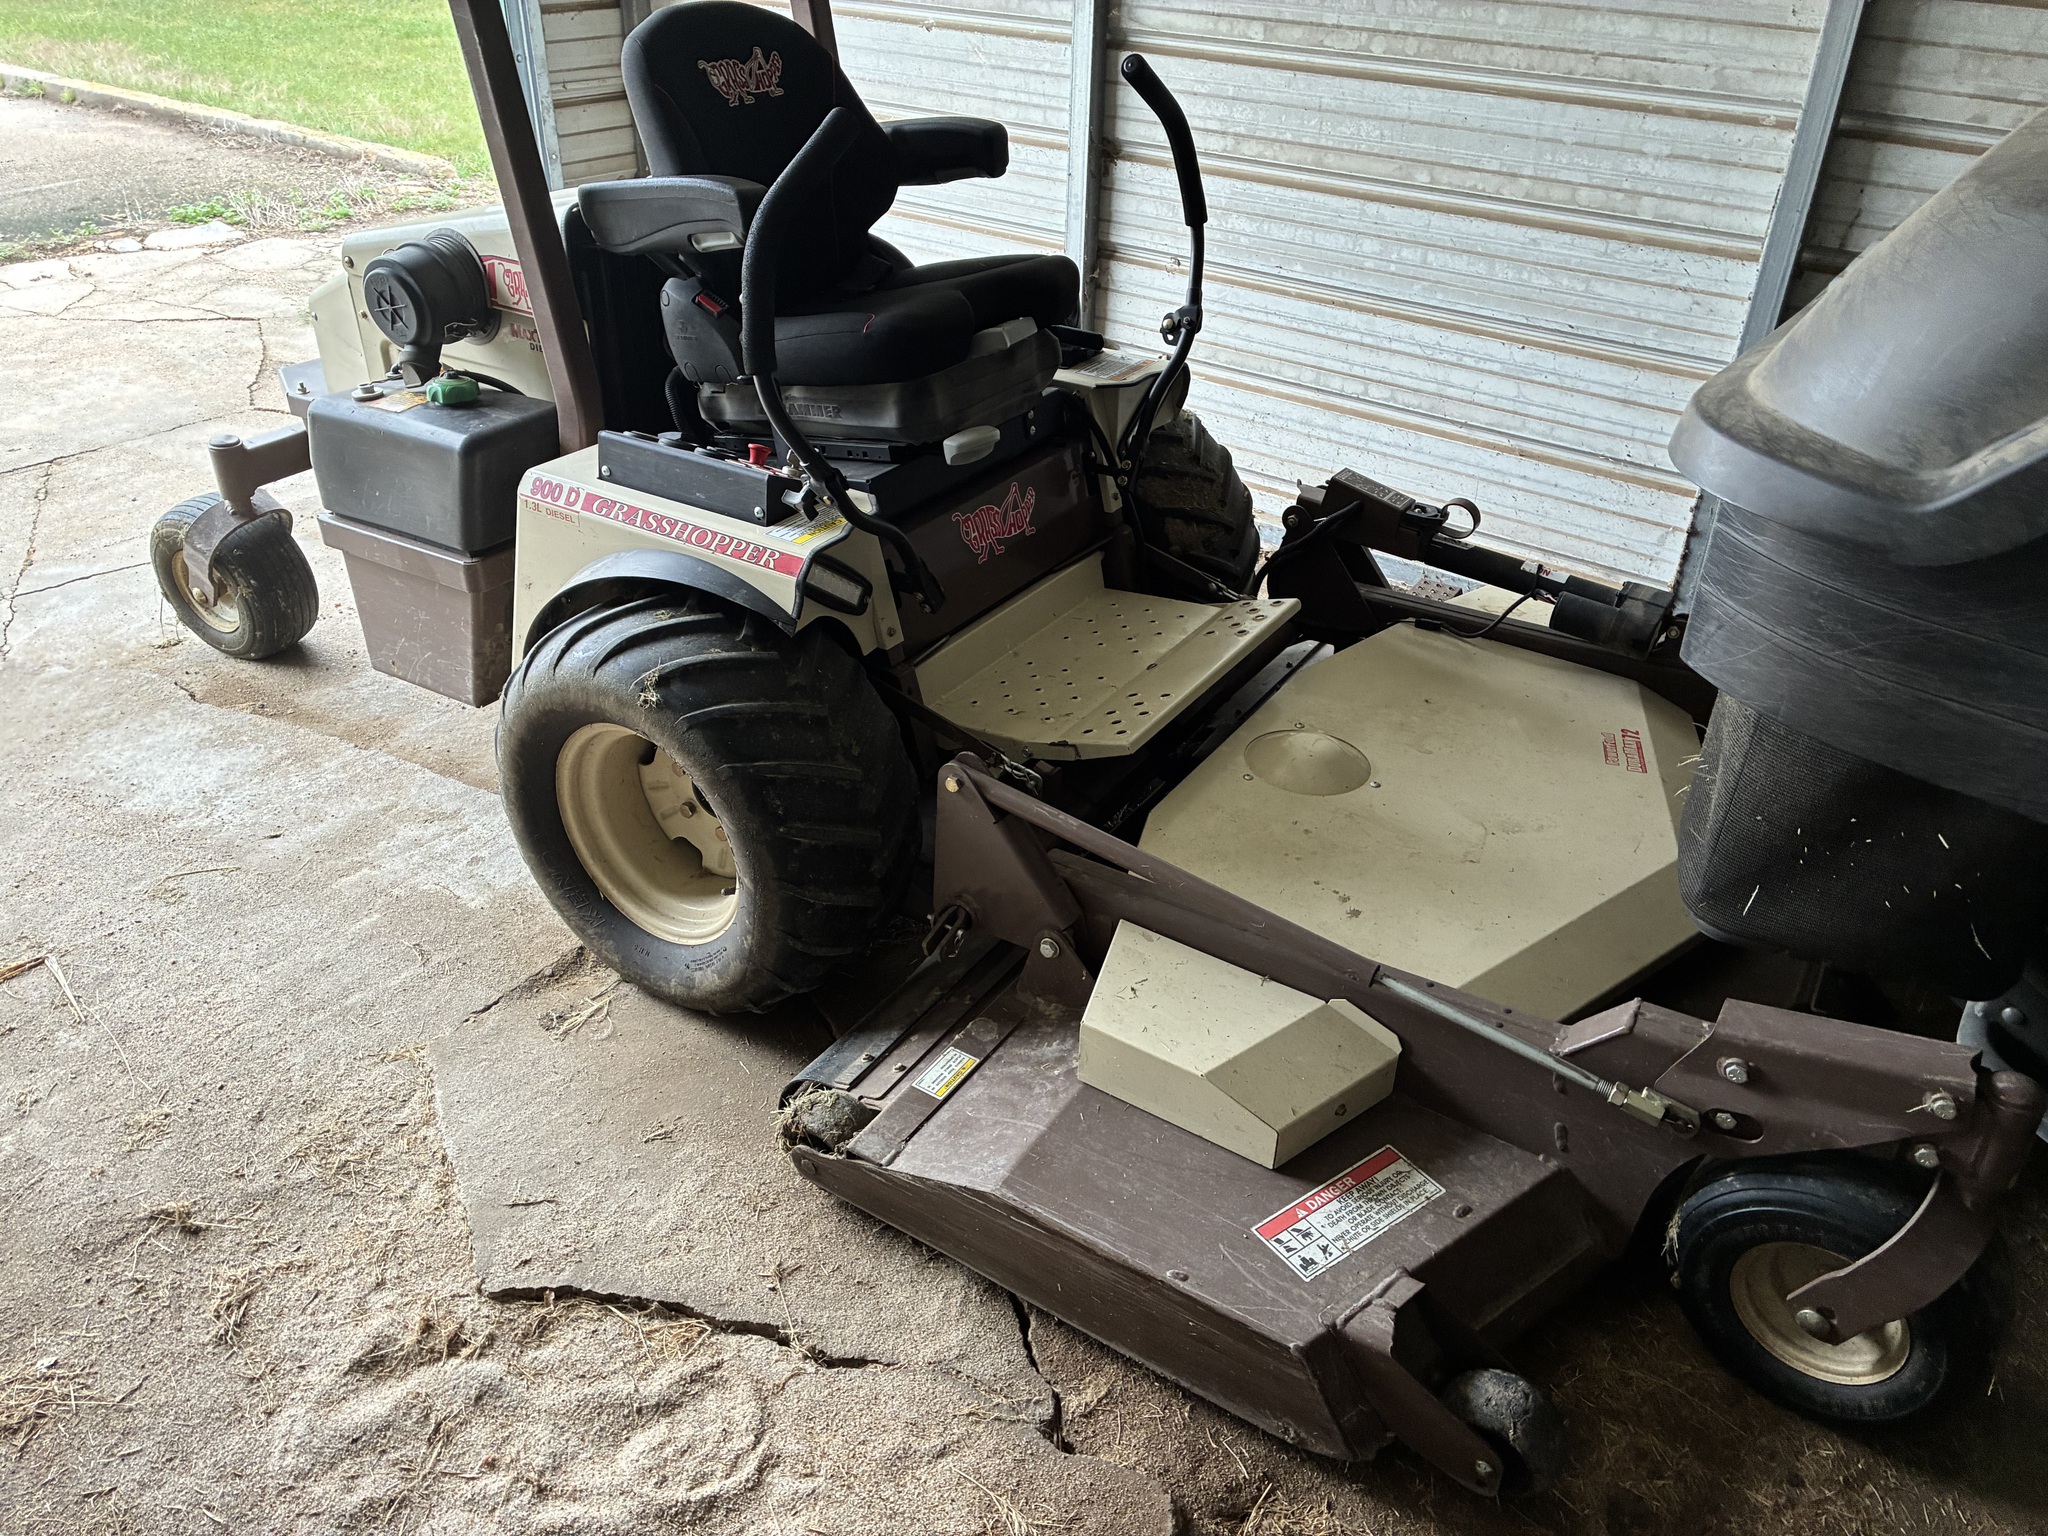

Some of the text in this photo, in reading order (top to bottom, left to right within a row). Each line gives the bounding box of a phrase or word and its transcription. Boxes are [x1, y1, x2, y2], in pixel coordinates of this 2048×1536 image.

[530, 476, 581, 507] 900 D
[524, 499, 576, 524] 1.3L DIESEL
[591, 497, 781, 570] GRASSHOPPER
[1305, 1176, 1357, 1211] DANGER
[1324, 1170, 1402, 1221] TO AVOID SERIOUS INJURY OR
[1327, 1173, 1411, 1229] DEATH FROM THROWN OBJECTS
[1336, 1176, 1380, 1206] KEEP AWAY!
[1331, 1179, 1429, 1244] NEVER OPERATE WITHOUT DISCHARGE
[1347, 1215, 1358, 1224] OR
[1356, 1203, 1376, 1219] BLADE
[1361, 1224, 1371, 1233] OR
[1370, 1216, 1385, 1228] SIDE
